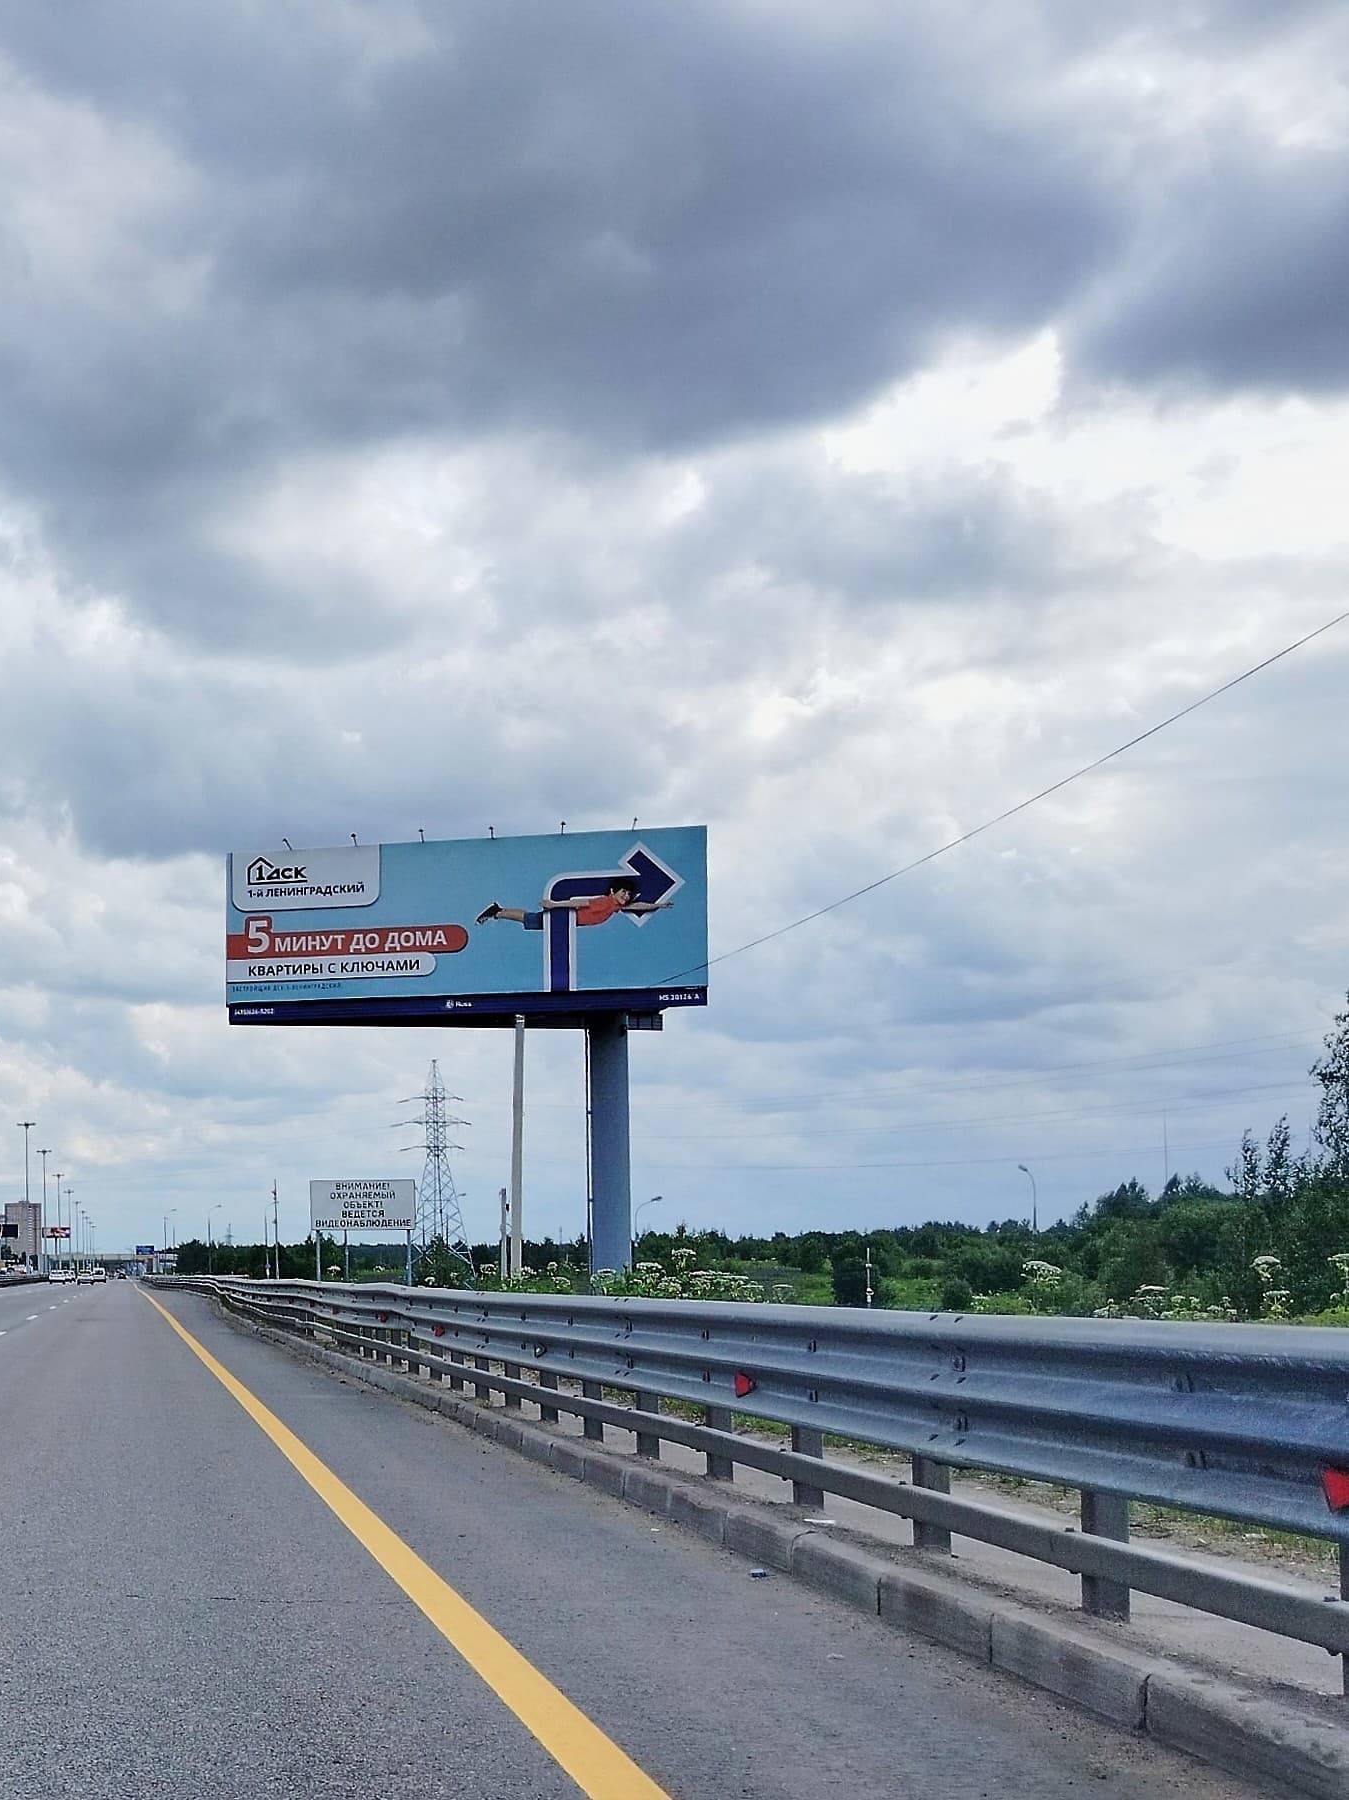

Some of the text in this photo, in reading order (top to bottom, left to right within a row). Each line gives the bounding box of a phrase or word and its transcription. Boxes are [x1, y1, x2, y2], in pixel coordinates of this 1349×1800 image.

[248, 882, 365, 898] 1-й ЛЕНИНГРАДСКИЙ
[247, 920, 447, 953] 5 МИНУТ ДО ДОМА
[248, 959, 420, 977] КВАРТИРЫ С КЛЮЧАМИ
[330, 1191, 396, 1200] ОХРАНЯЕМЫЙ
[343, 1200, 383, 1209] ОБЪЕКТ!
[341, 1209, 385, 1218] ВЕДЕТСЯ
[315, 1219, 411, 1228] ВИДЕОНАБЛЮДЕНИЕ
